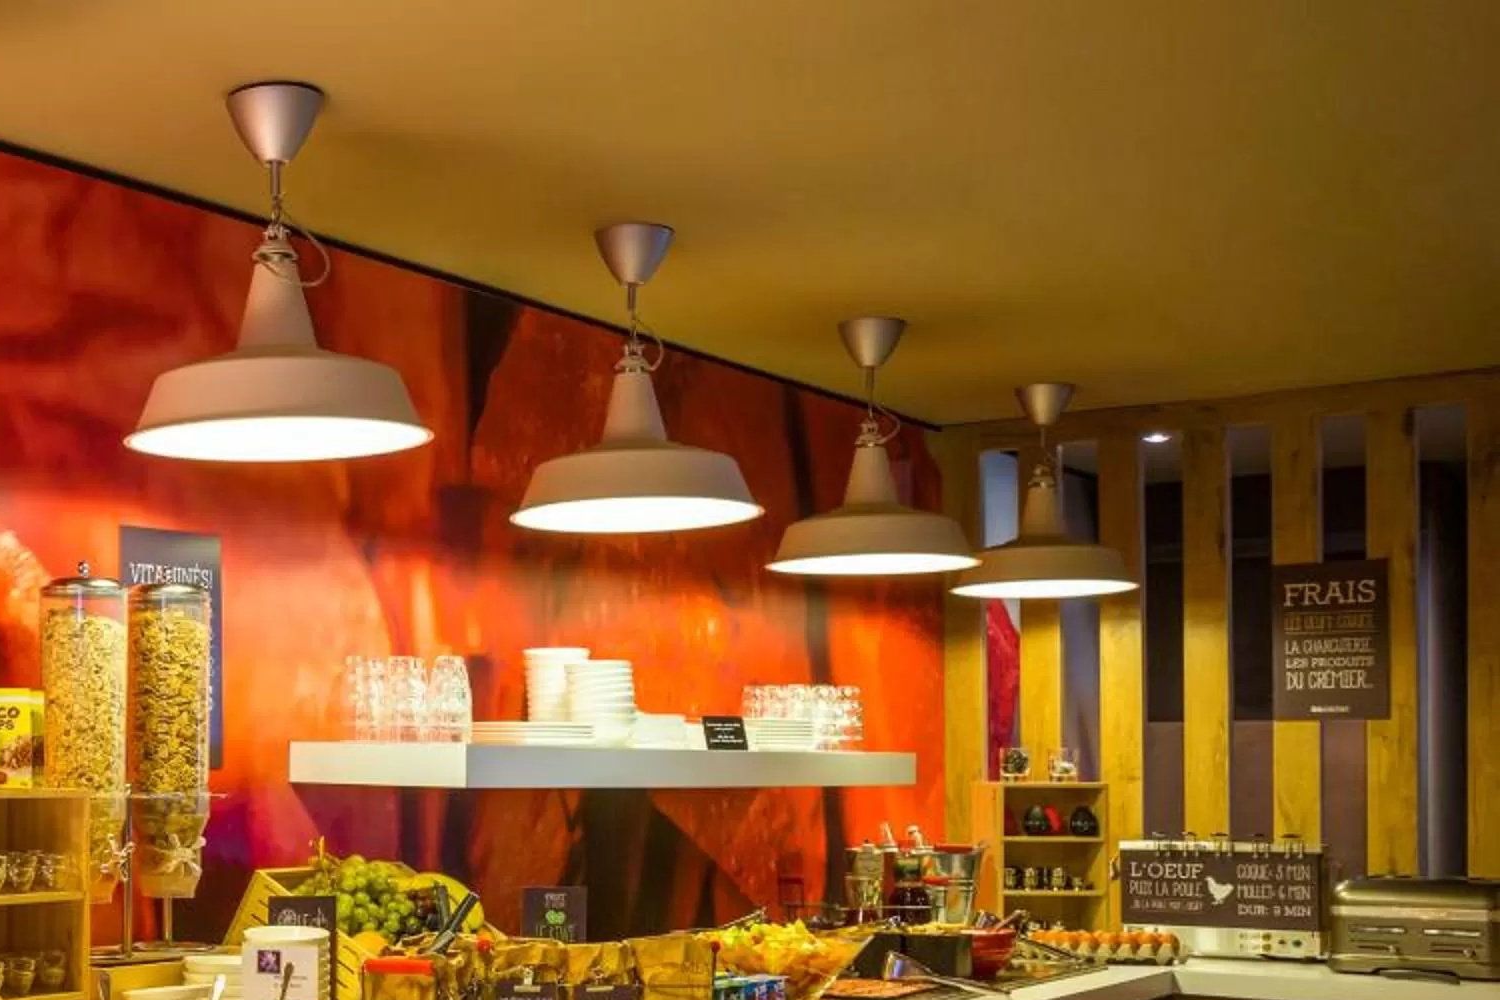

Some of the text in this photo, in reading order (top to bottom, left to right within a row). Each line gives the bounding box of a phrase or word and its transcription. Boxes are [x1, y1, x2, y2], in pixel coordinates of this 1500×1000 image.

[1283, 580, 1376, 607] FRAIS
[1285, 672, 1304, 691] DU
[1129, 862, 1204, 879] L'OEUF
[1155, 881, 1170, 897] LA
